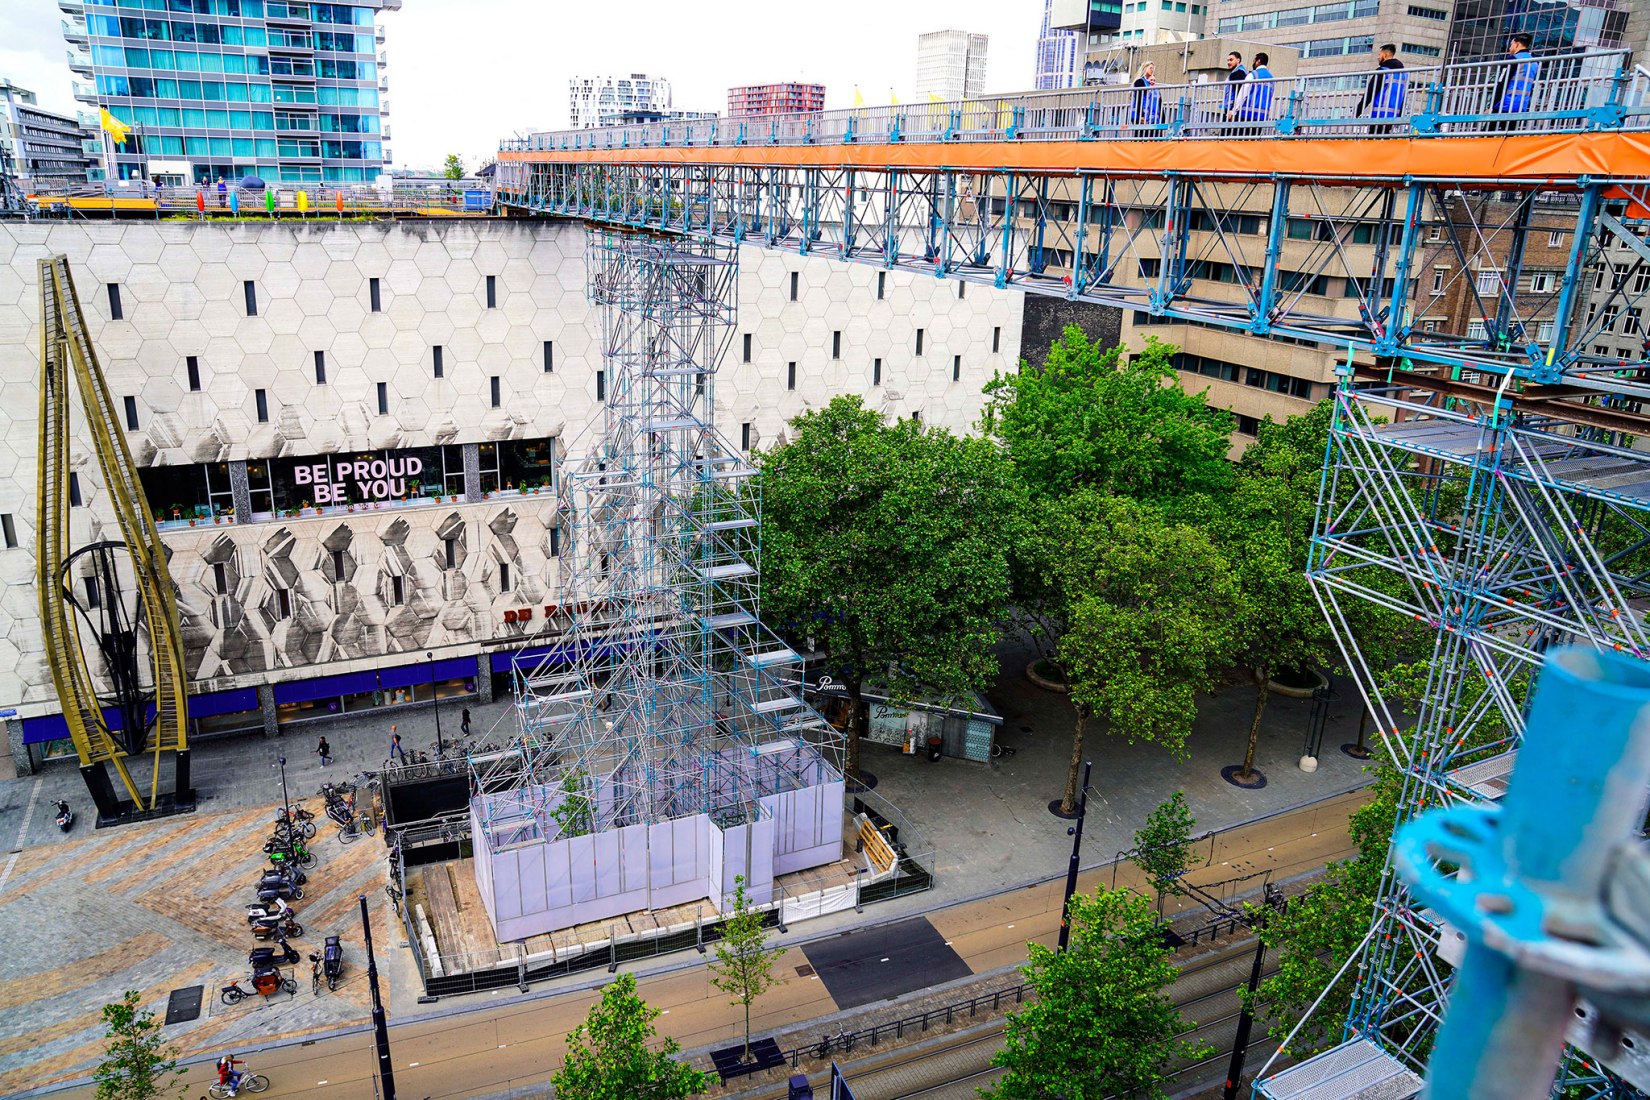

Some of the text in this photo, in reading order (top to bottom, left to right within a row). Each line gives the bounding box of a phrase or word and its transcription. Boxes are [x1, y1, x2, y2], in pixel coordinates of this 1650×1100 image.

[294, 457, 423, 485] BE PROUD
[313, 478, 405, 503] BE YOU
